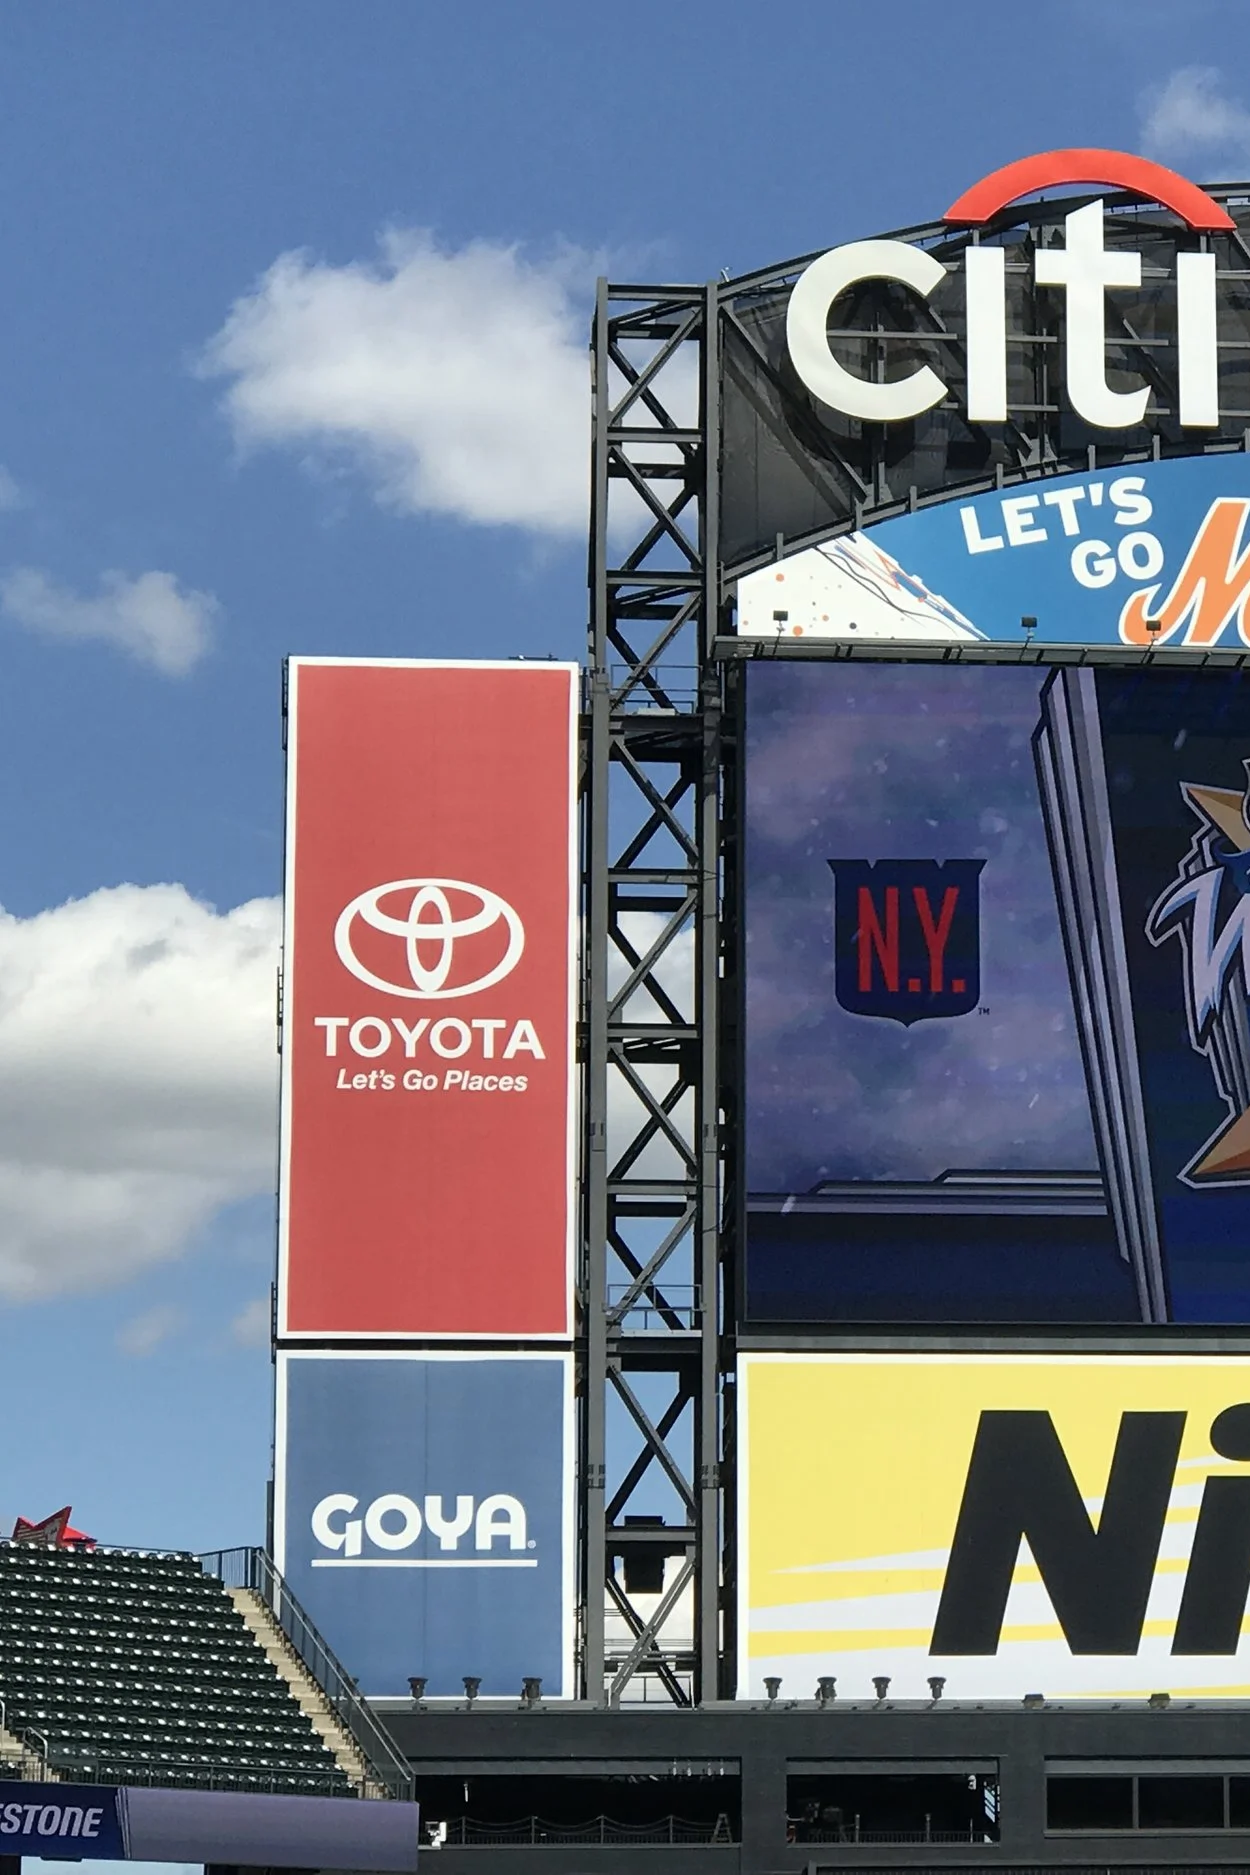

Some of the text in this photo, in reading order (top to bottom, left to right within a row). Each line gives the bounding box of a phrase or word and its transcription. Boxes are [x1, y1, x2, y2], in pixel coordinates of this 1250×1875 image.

[786, 199, 1219, 428] citi
[960, 477, 1153, 555] LET'S
[1070, 532, 1165, 589] GO
[857, 885, 966, 993] N.Y.
[314, 1016, 546, 1060] TOYOTA
[336, 1067, 529, 1092] Let's Go Places
[311, 1493, 527, 1557] GOYA
[0, 1803, 104, 1837] STONE
